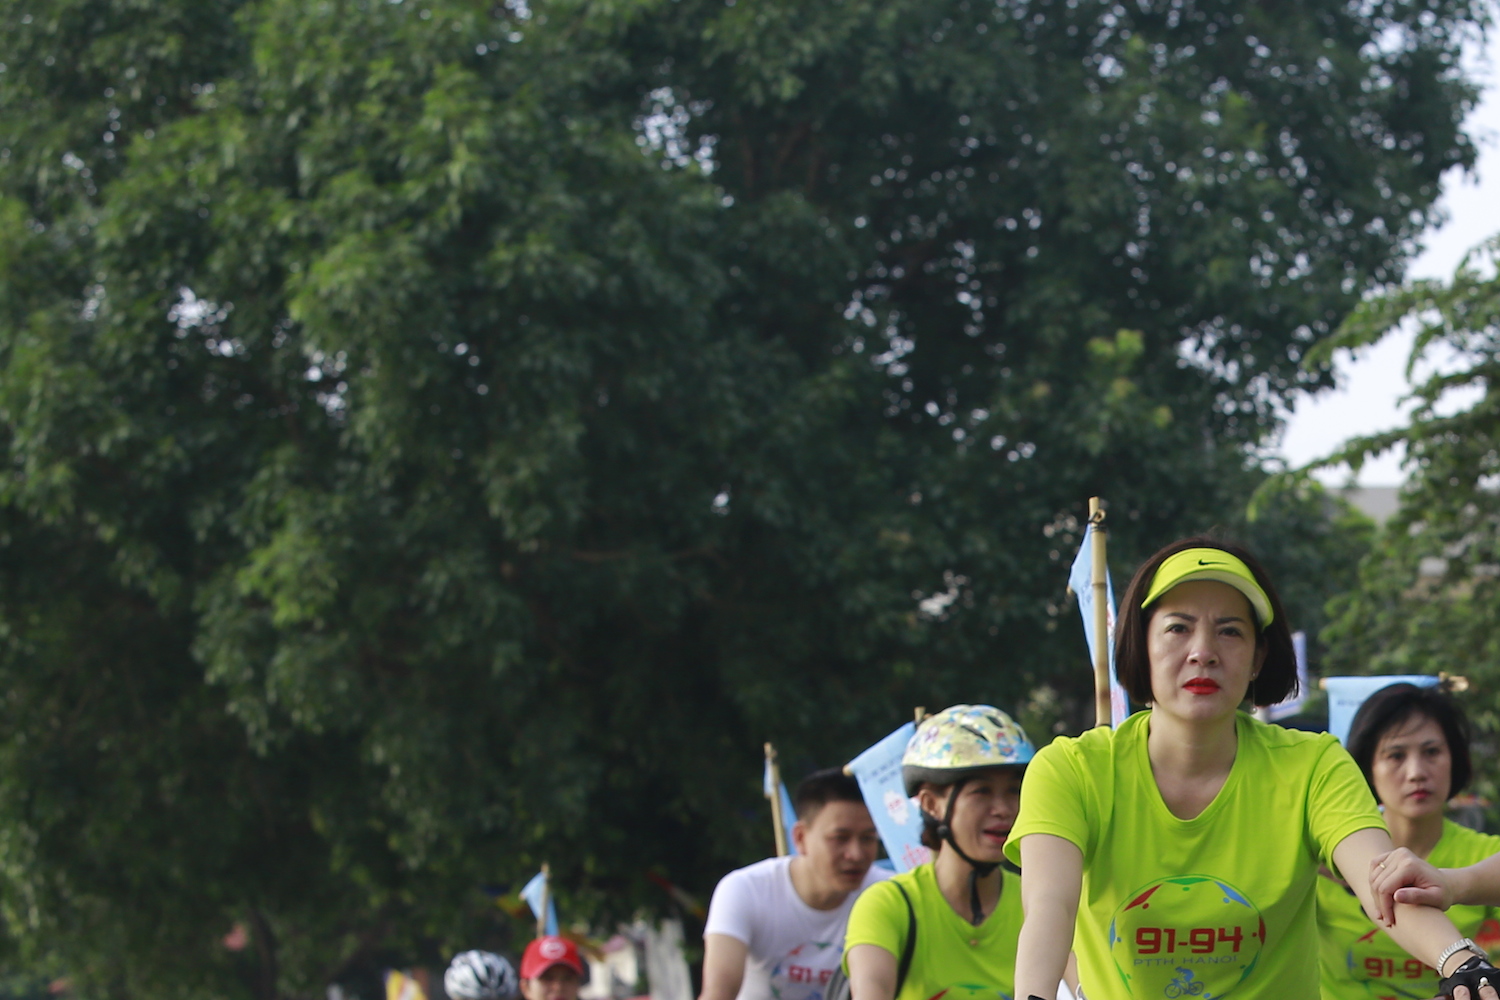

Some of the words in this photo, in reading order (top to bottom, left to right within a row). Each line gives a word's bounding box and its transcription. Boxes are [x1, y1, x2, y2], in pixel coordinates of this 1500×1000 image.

[1135, 926, 1243, 954] 91-94
[1133, 957, 1175, 967] PTTH
[1182, 955, 1238, 965] HANOI
